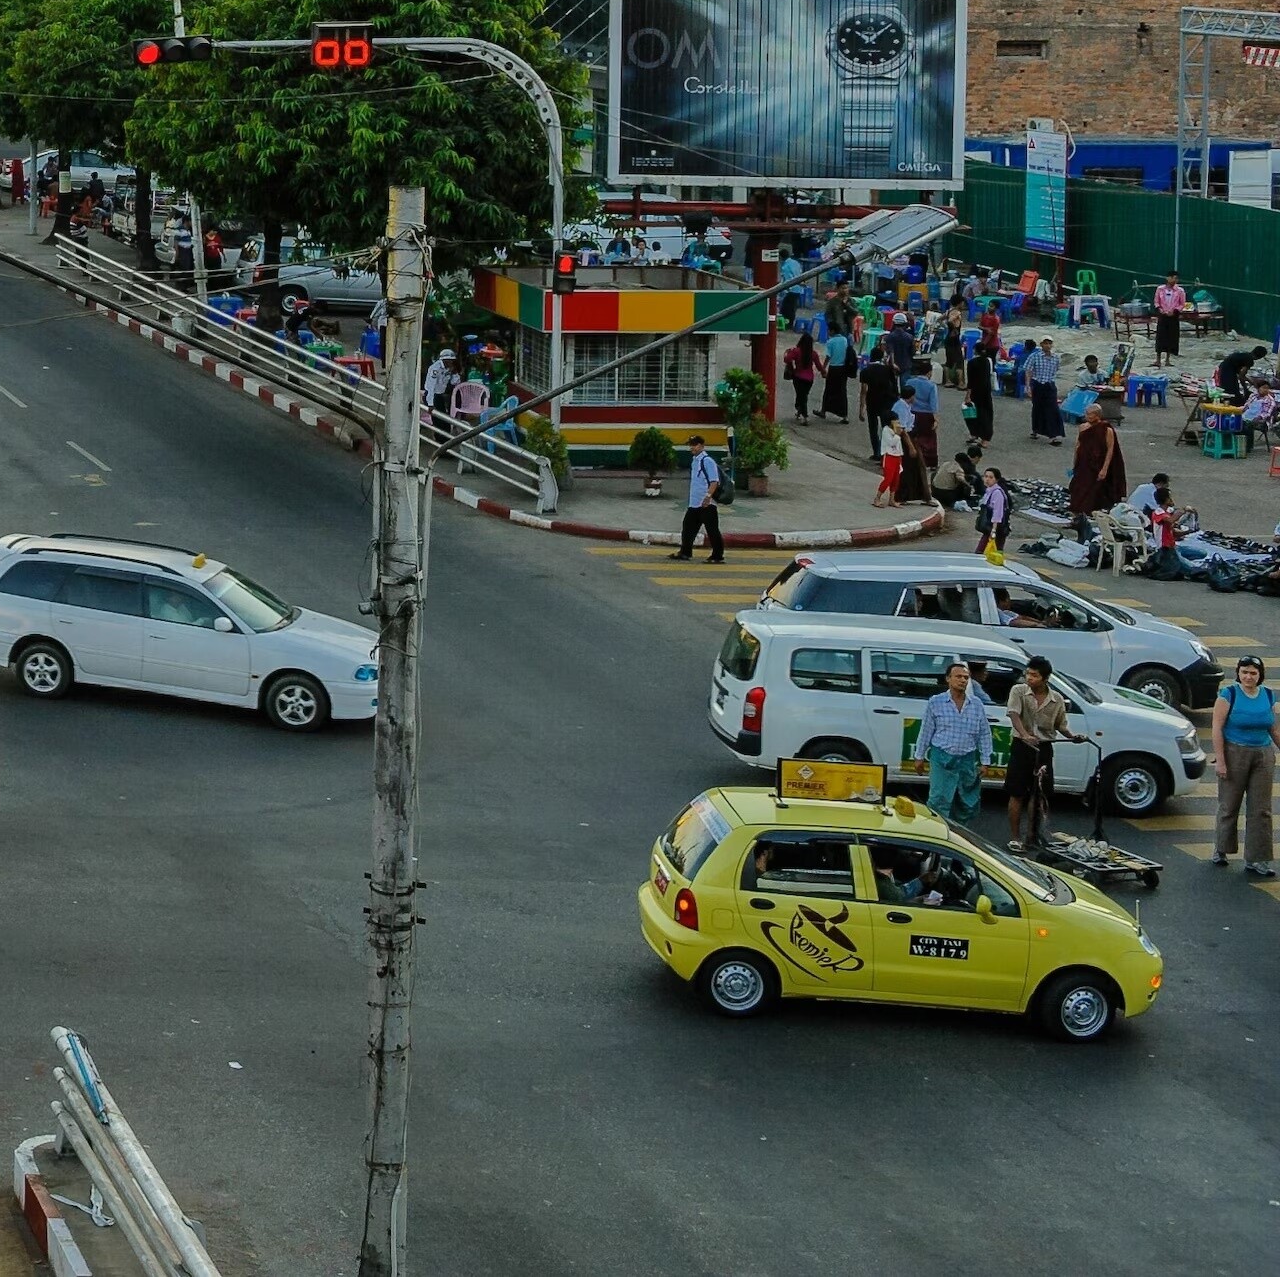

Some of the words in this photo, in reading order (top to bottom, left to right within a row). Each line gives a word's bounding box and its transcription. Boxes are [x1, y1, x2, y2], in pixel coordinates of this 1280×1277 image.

[315, 40, 369, 66] 00
[897, 161, 942, 173] OMEGA
[786, 781, 826, 791] PREMIER
[919, 936, 938, 945] CITY
[942, 938, 963, 947] TAXI
